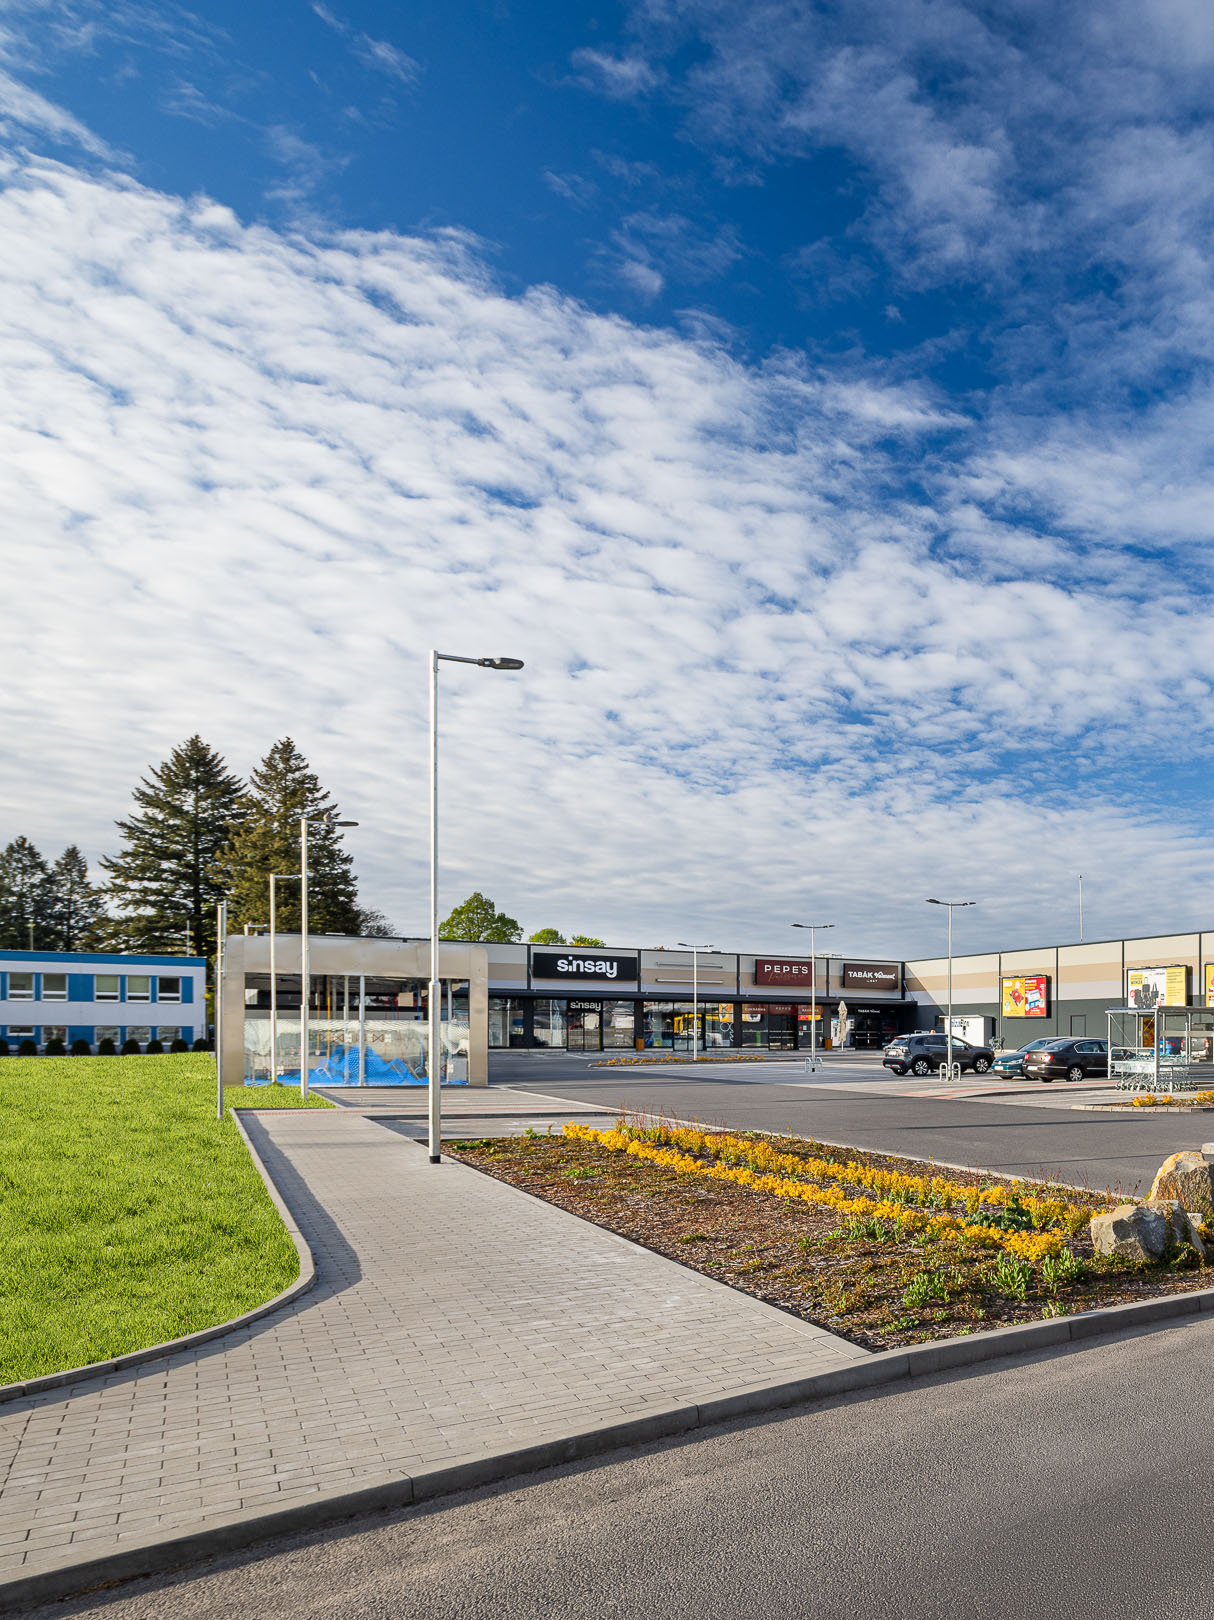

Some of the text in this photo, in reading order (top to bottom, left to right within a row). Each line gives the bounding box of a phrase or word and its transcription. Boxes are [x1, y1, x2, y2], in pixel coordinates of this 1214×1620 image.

[556, 956, 618, 978] sinsay
[764, 964, 809, 974] PEPE'S
[847, 970, 873, 978] TABÁK
[570, 1001, 602, 1012] sinsay
